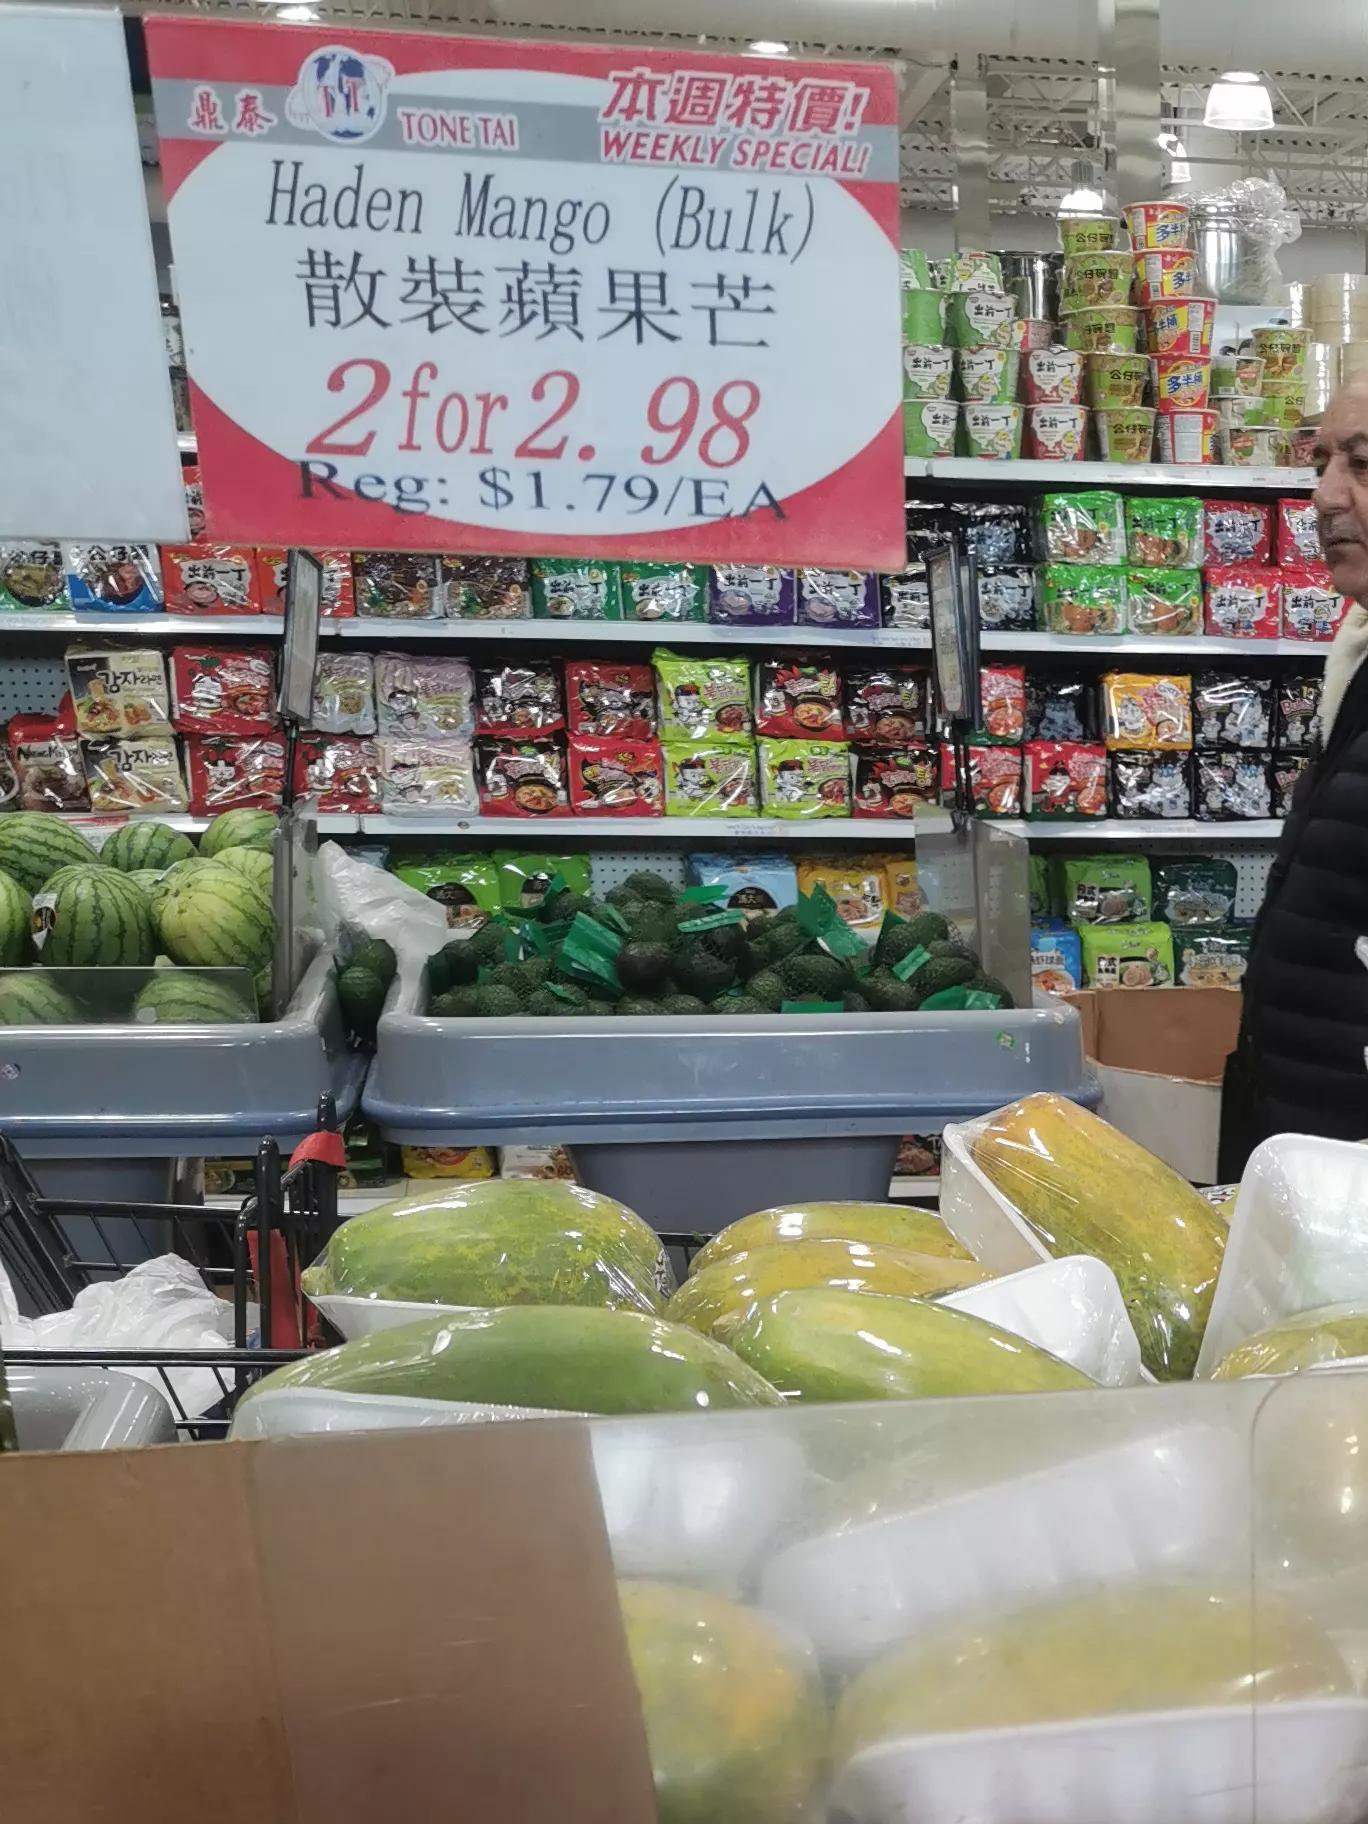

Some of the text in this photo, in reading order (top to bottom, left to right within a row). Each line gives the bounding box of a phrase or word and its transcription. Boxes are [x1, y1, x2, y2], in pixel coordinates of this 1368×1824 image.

[190, 90, 276, 133] 鼎泰
[601, 70, 867, 136] 本週特價!
[400, 111, 517, 147] TONE TAI
[602, 129, 870, 174] WEEKLY SPECIAL!
[264, 160, 815, 265] Haden Mango (Bulk)
[296, 247, 778, 349] 散裝蘋果芒
[300, 459, 787, 520] Reg: $1.79/EA
[188, 565, 247, 582] 出前一丁
[1214, 594, 1265, 610] 出前一丁
[1291, 594, 1341, 609] 出前一丁
